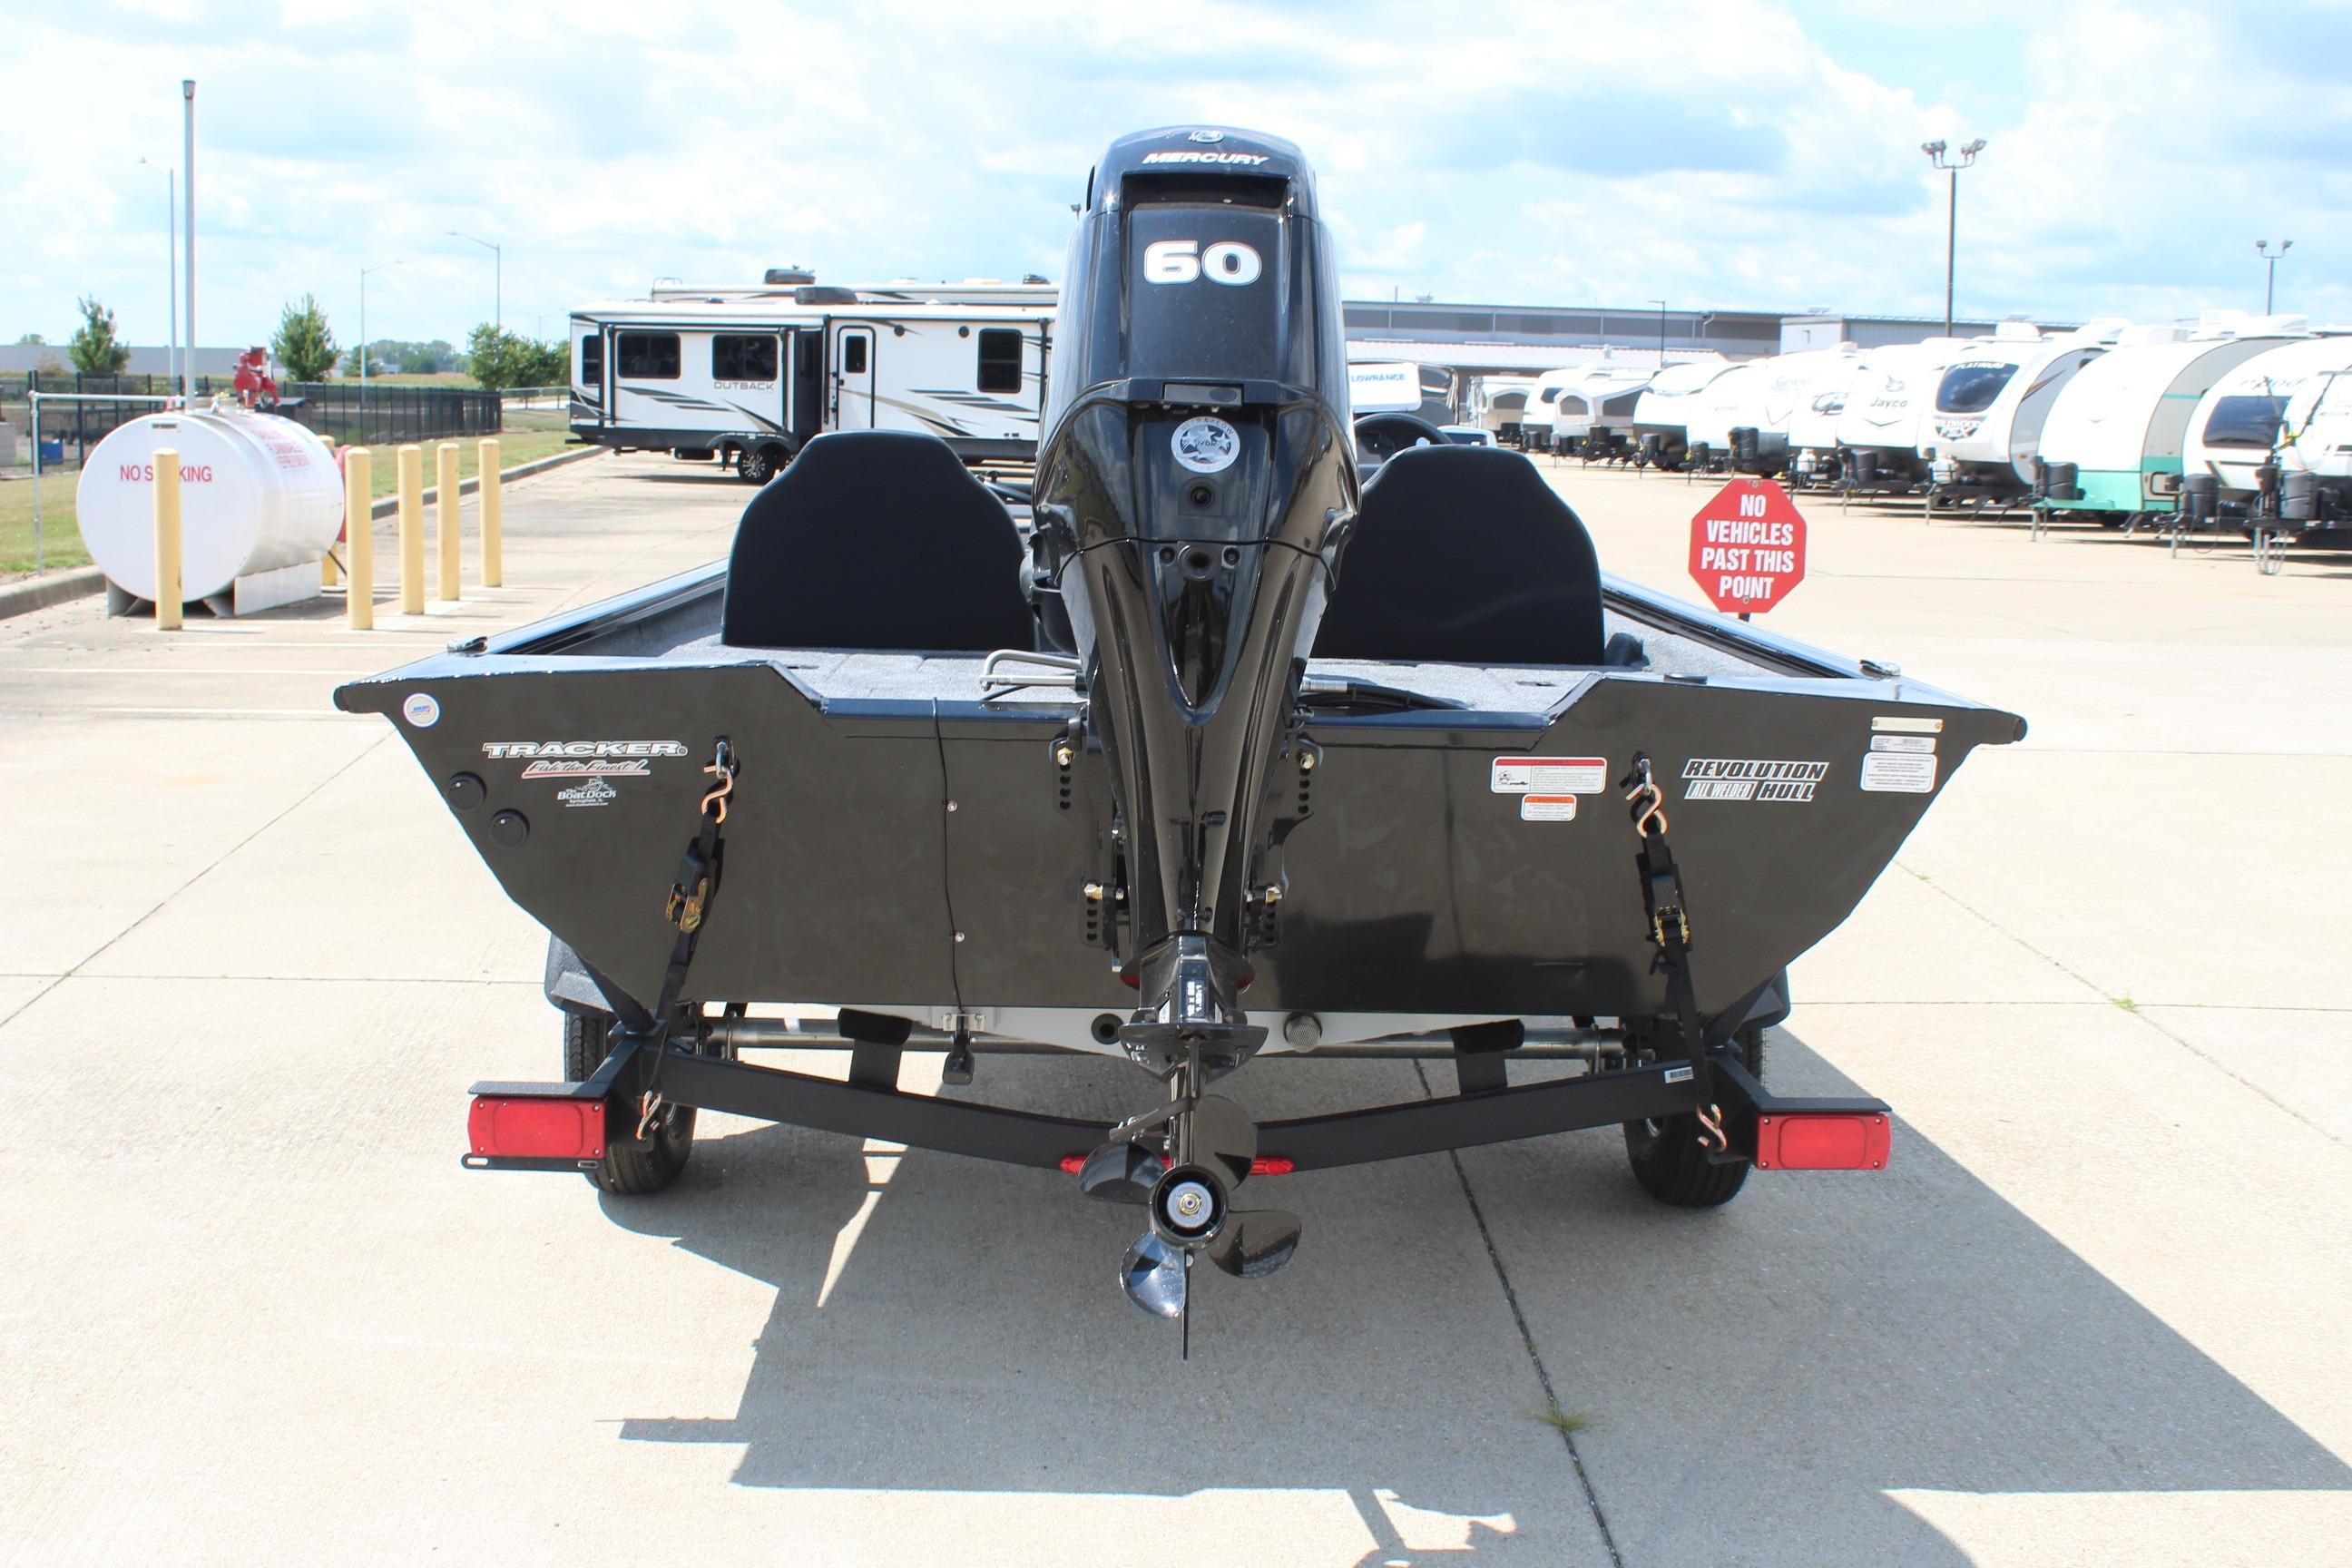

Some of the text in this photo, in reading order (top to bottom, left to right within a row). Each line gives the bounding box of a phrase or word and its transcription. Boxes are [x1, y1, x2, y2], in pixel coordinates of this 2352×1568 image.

[1142, 152, 1269, 166] MERCURY
[1144, 240, 1262, 287] 60
[713, 381, 774, 390] OUTBACK
[1351, 373, 1406, 382] LOWRANCE
[1869, 397, 1908, 410] Jayco
[120, 465, 212, 483] NO SKING
[1740, 494, 1767, 517] NO
[1707, 520, 1794, 546] VEHICLES
[1700, 547, 1795, 573] PAST THIS
[1719, 575, 1775, 599] POINT
[528, 760, 564, 772] Fish
[1682, 760, 1828, 781] REVOLUTION
[557, 789, 617, 800] Boat Dock
[1690, 781, 1815, 800] ALL WELDED HULL
